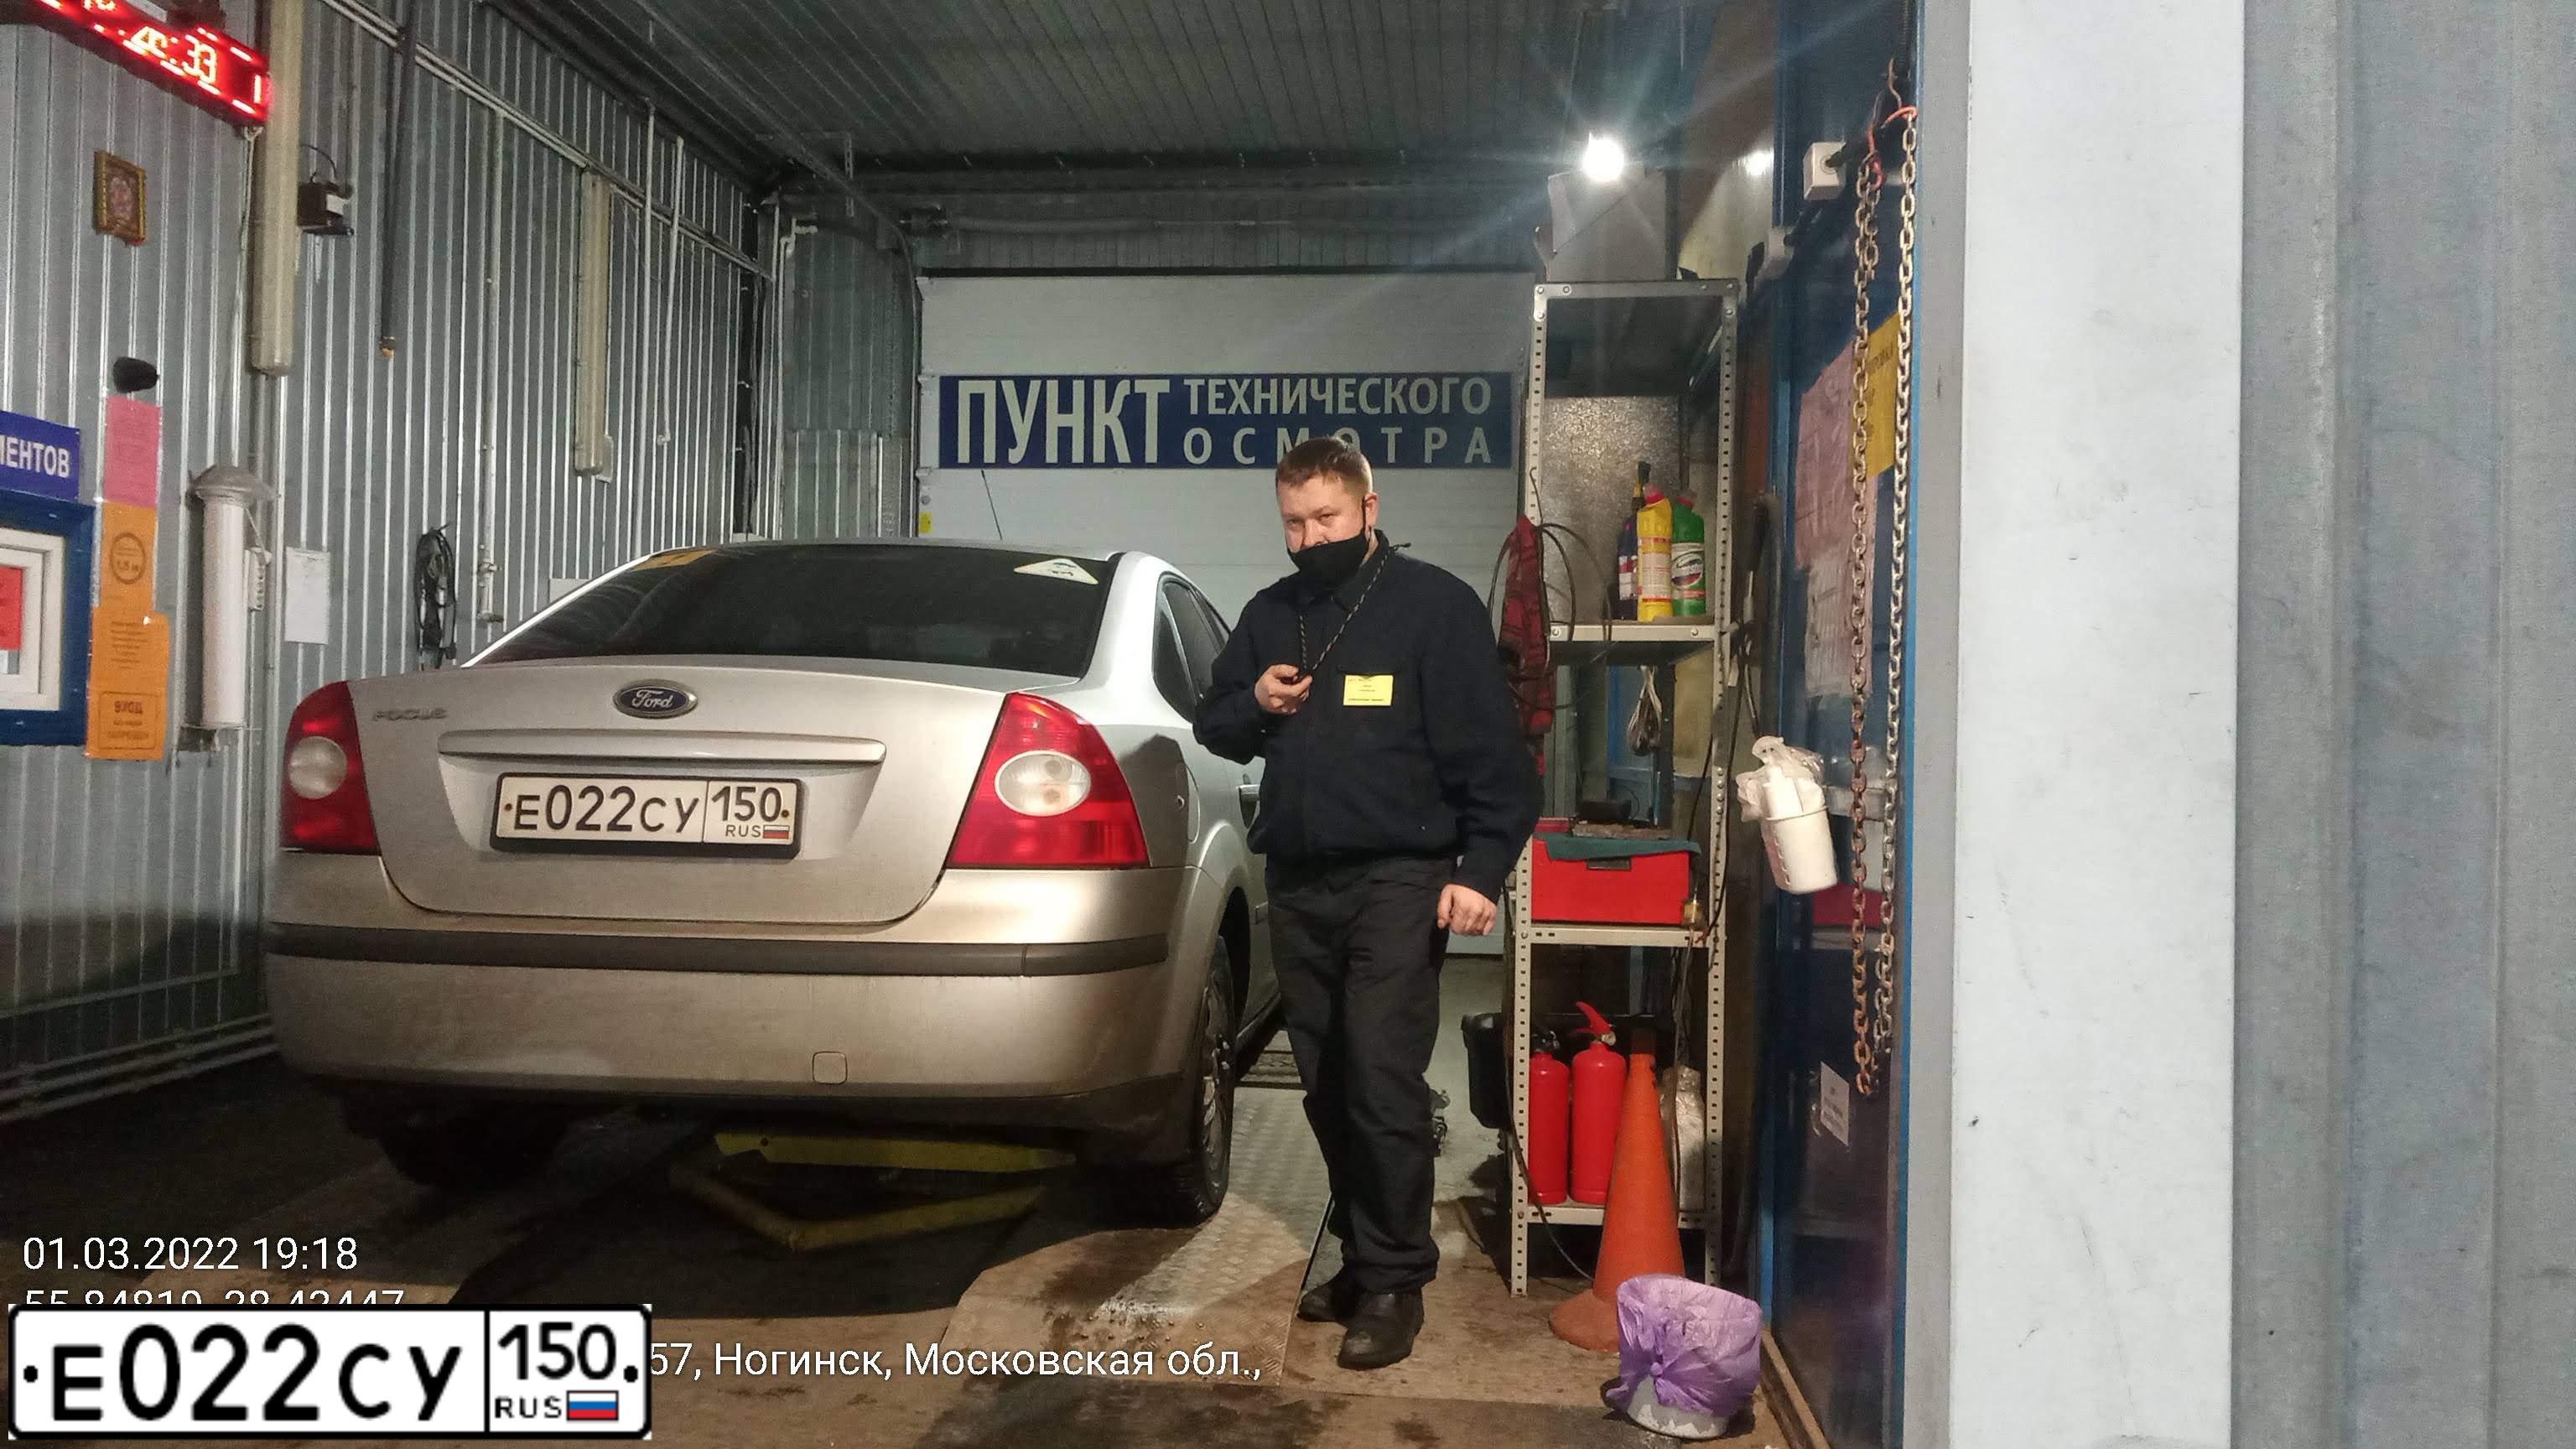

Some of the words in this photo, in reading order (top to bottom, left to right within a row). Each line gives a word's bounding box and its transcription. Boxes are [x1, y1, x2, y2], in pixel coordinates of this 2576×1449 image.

[1183, 377, 1492, 415] ТЕХНИЧЕСКОГО
[958, 379, 1171, 465] ПУНКТ
[631, 689, 673, 708] Ford
[711, 786, 782, 823] 150
[724, 824, 761, 838] RUS
